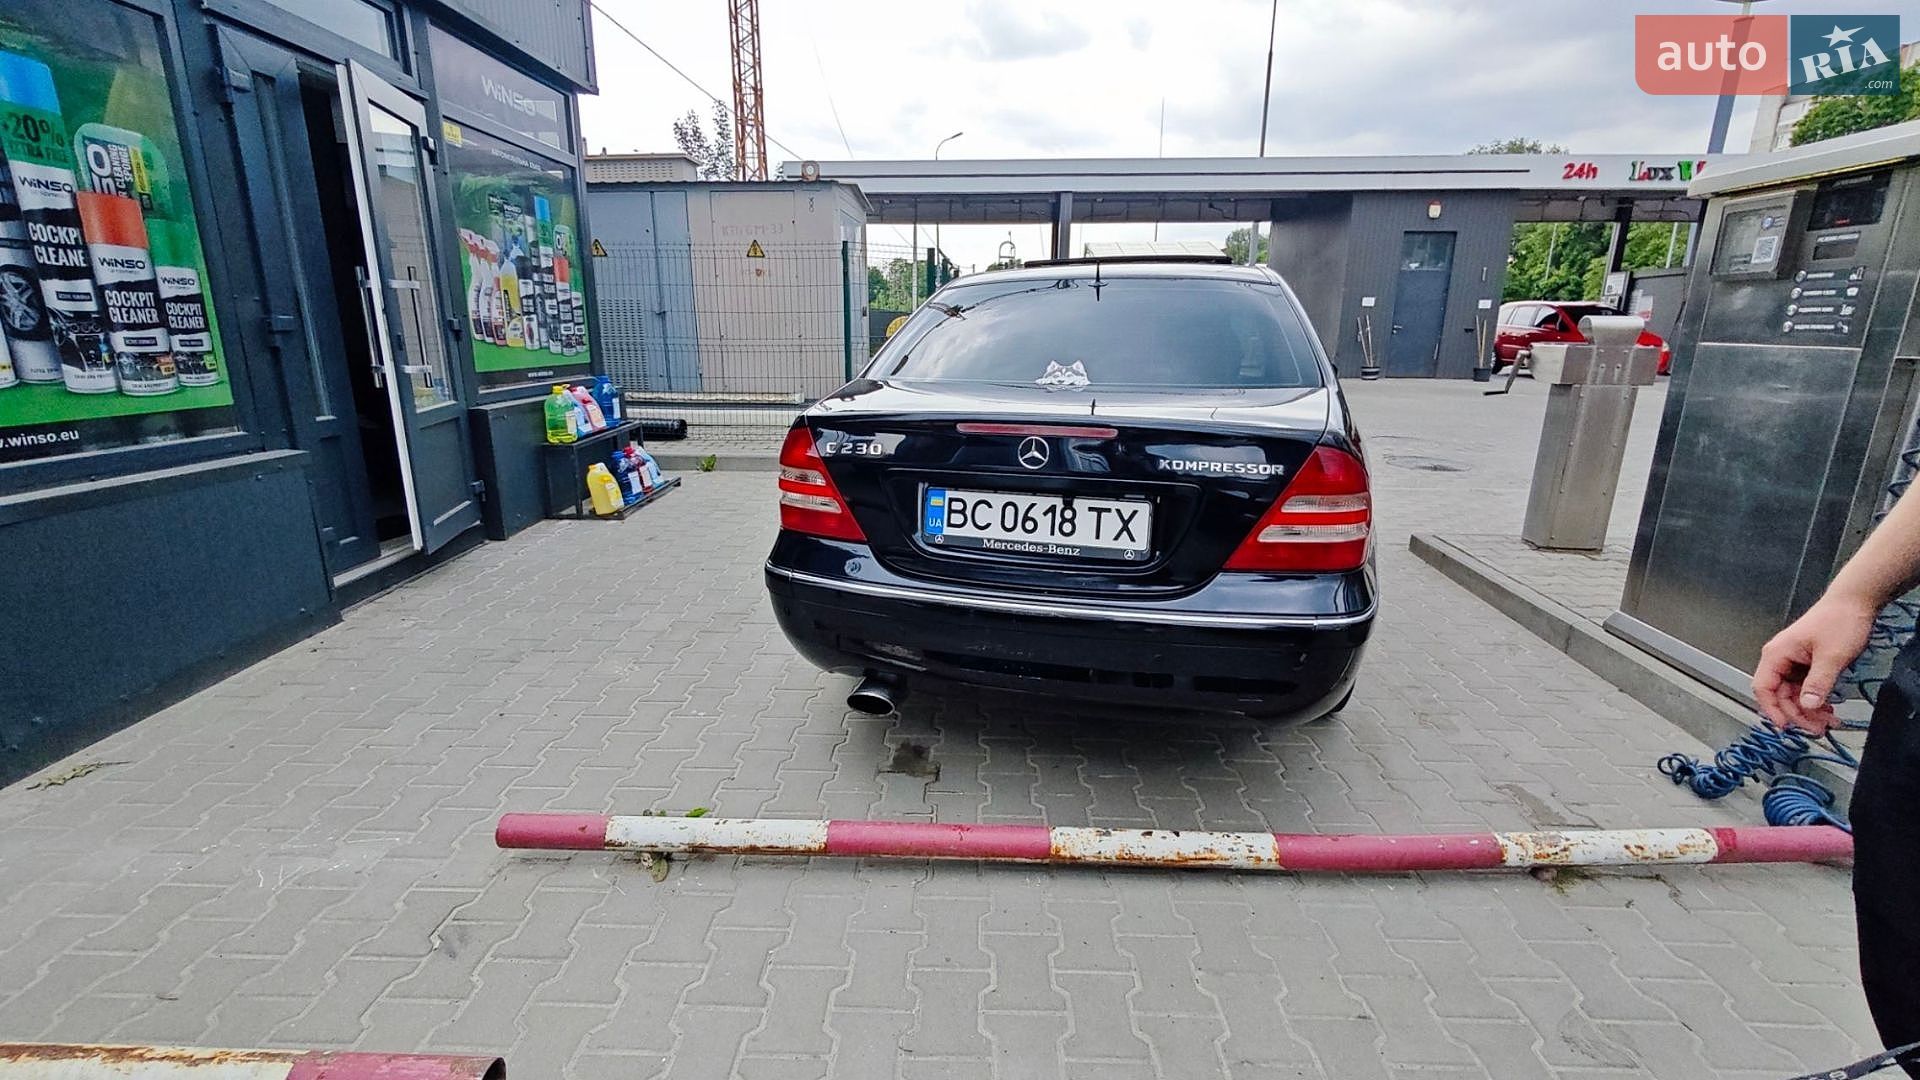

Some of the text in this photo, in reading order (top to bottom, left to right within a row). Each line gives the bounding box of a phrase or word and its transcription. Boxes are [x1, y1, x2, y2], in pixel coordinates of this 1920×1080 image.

[107, 144, 126, 188] CLEANING
[118, 144, 134, 183] SPONGE
[1562, 161, 1600, 180] 24h
[1629, 161, 1676, 181] Lux
[104, 290, 156, 308] COCKPIT
[108, 307, 160, 324] CLEANER
[165, 302, 203, 316] COCKPIT
[168, 315, 206, 329] CLEANER
[826, 442, 882, 455] C 230
[1159, 459, 1284, 475] KOMPRESSOR
[928, 517, 942, 528] UA
[946, 497, 1139, 543] BC 0618 TX
[982, 538, 1081, 556] Mercedes-Benz
